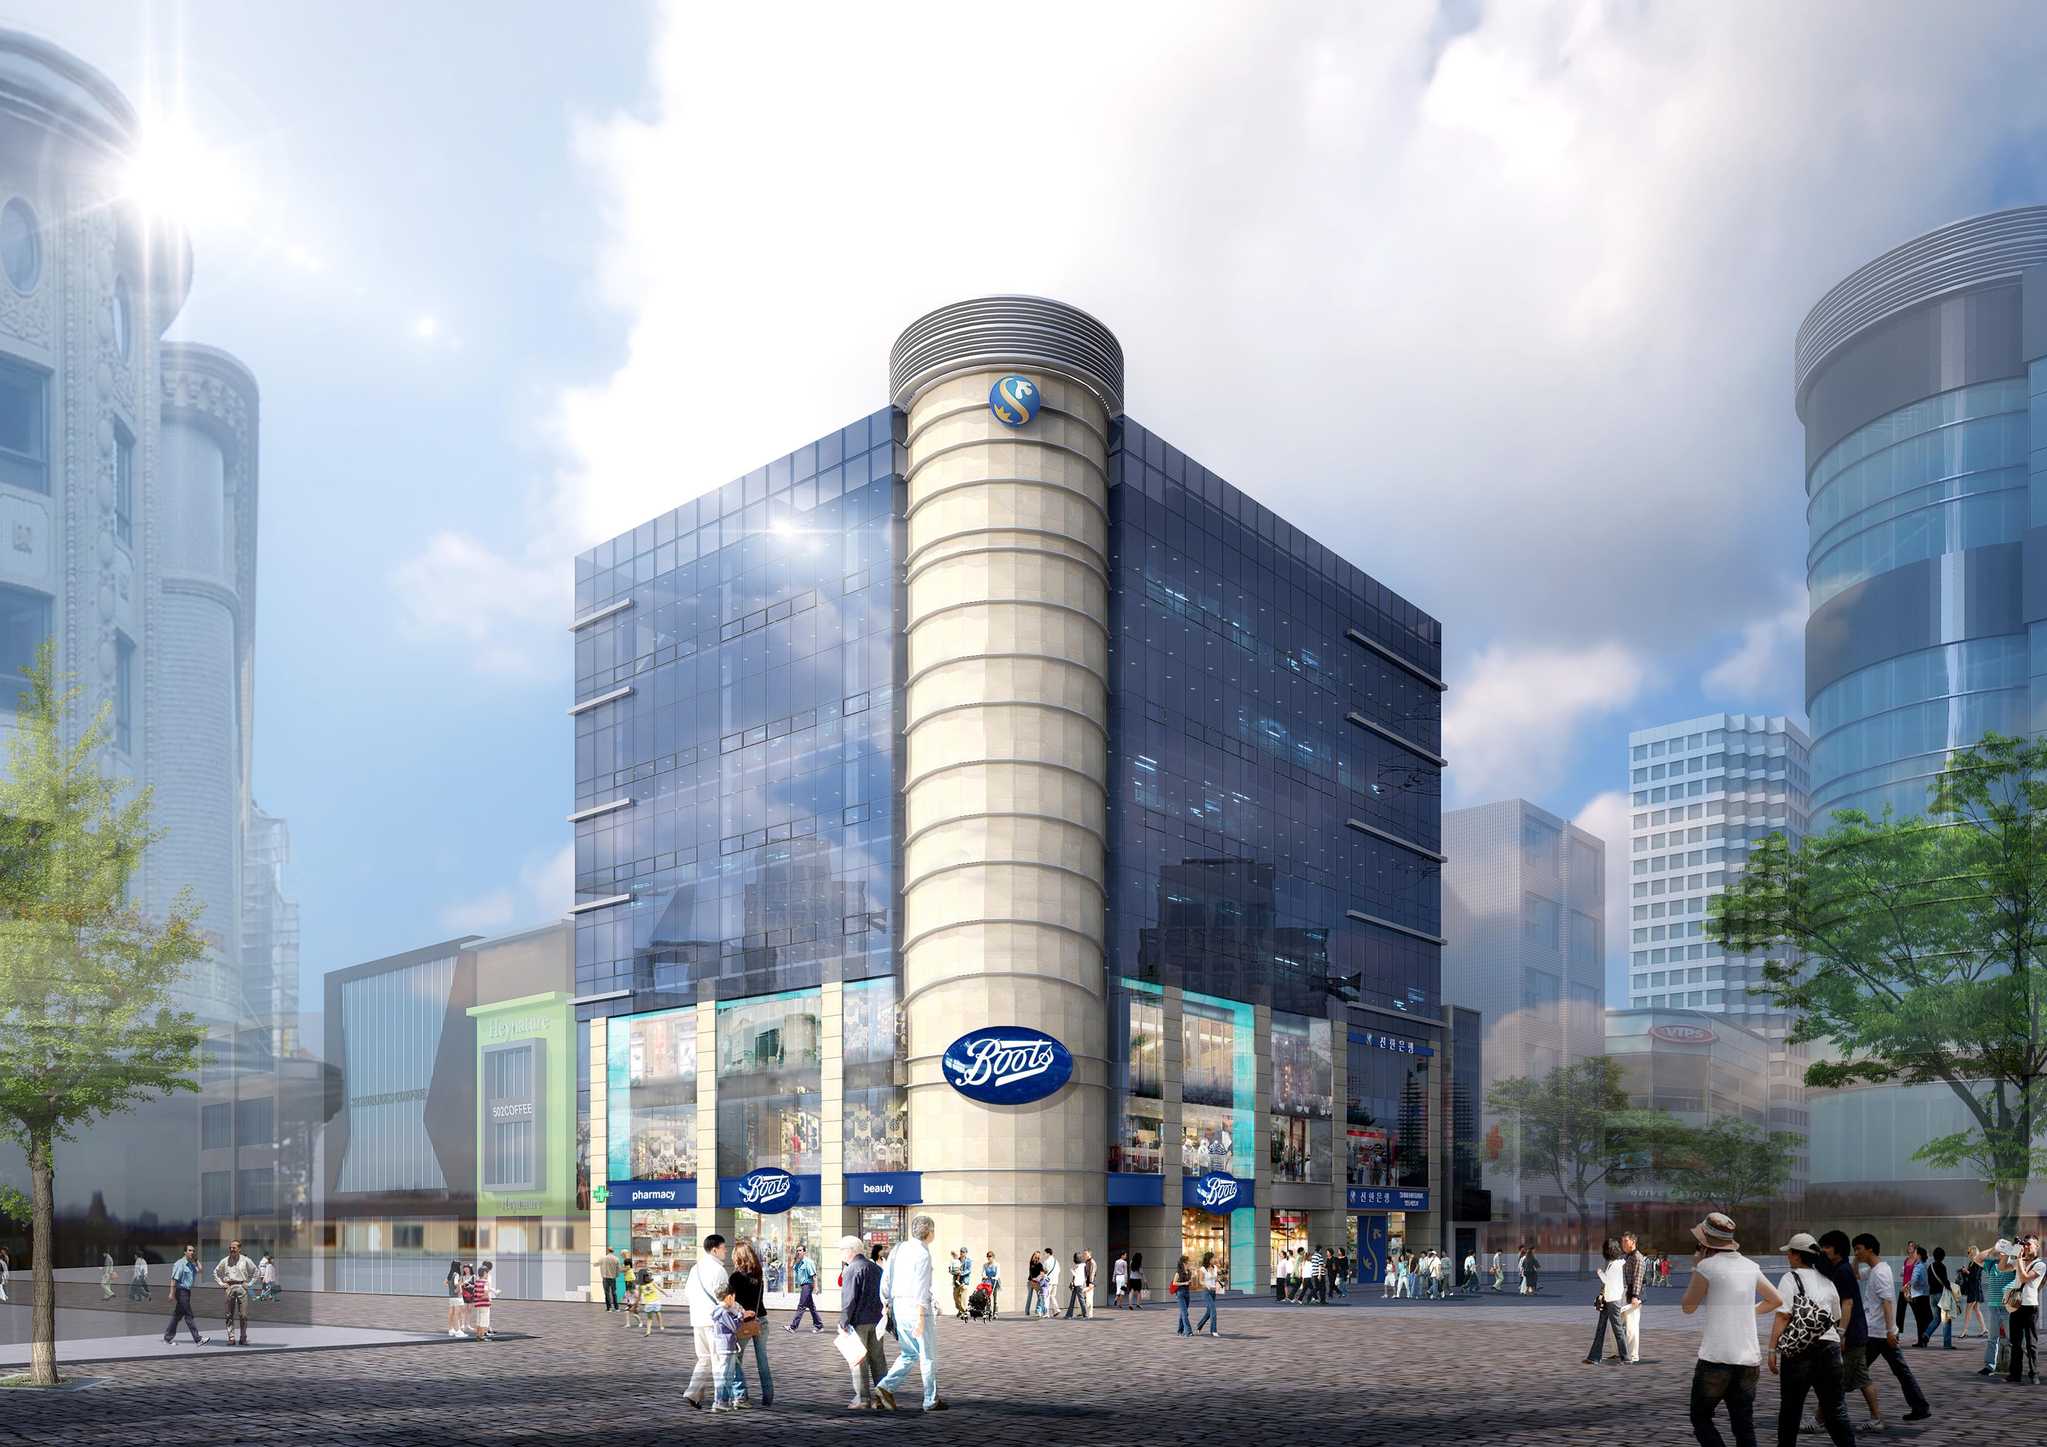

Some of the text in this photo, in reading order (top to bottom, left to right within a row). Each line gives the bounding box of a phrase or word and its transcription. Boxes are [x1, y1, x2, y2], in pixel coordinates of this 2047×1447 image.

[489, 1015, 550, 1041] Heynature
[1664, 1027, 1704, 1039] VIPS
[1379, 1036, 1415, 1055] 신한은행
[955, 1038, 1055, 1087] Boots
[492, 1103, 532, 1118] 502COFFEE
[632, 1190, 676, 1201] pharmacy
[743, 1174, 791, 1204] Boots
[863, 1183, 894, 1195] beauty
[1202, 1177, 1238, 1206] Boots
[1630, 1189, 1665, 1197] OLIVE
[501, 1196, 543, 1214] Heynature
[1360, 1191, 1390, 1204] 신한은행
